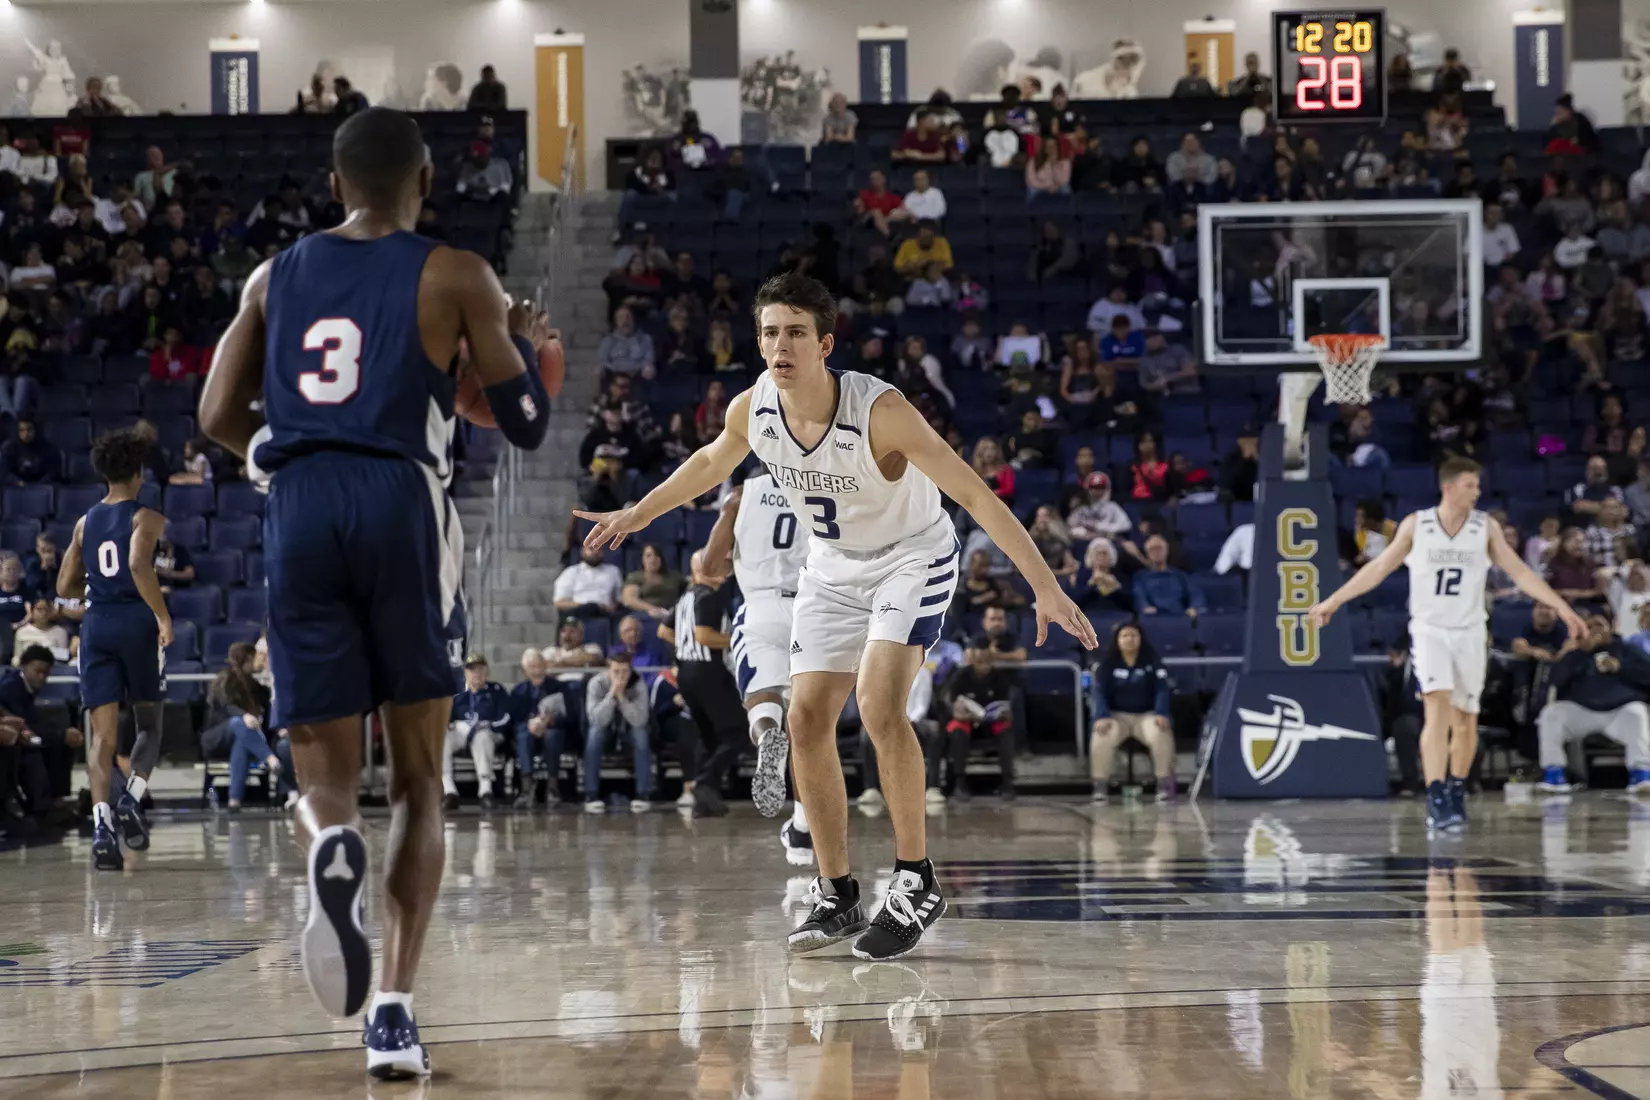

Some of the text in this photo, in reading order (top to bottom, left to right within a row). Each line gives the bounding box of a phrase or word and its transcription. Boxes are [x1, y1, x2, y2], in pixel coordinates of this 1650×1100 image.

[1295, 21, 1373, 54] 12 20
[1295, 55, 1362, 111] 28
[298, 316, 362, 405] 3
[834, 439, 855, 451] WAC
[767, 462, 860, 493] LANCERS
[772, 512, 798, 549] 0
[804, 496, 841, 540] 3
[98, 540, 120, 577] 0
[1435, 568, 1463, 596] 12
